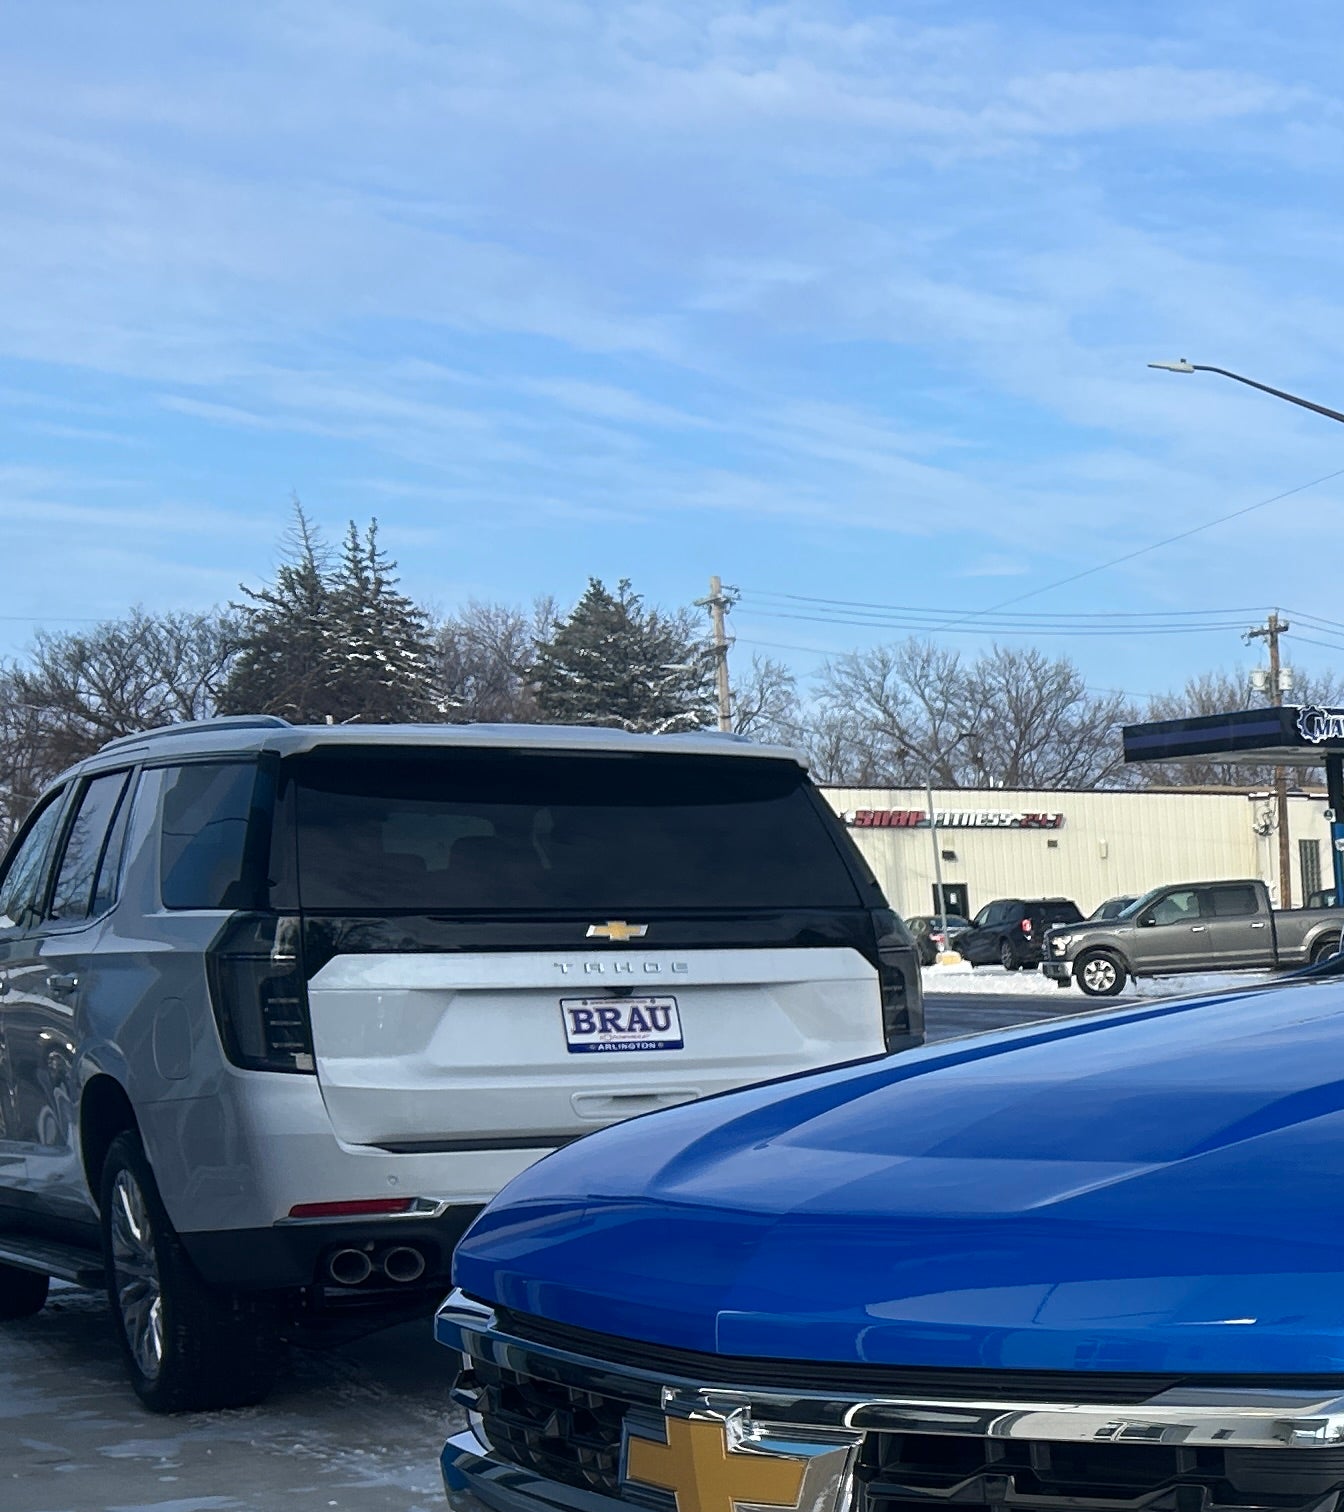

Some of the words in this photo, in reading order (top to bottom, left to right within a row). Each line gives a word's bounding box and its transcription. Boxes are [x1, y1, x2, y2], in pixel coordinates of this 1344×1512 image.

[932, 810, 1013, 827] FITNESS
[553, 961, 689, 974] TAHOE
[568, 1005, 671, 1035] BRAU
[597, 1042, 657, 1051] ARLINGTON
